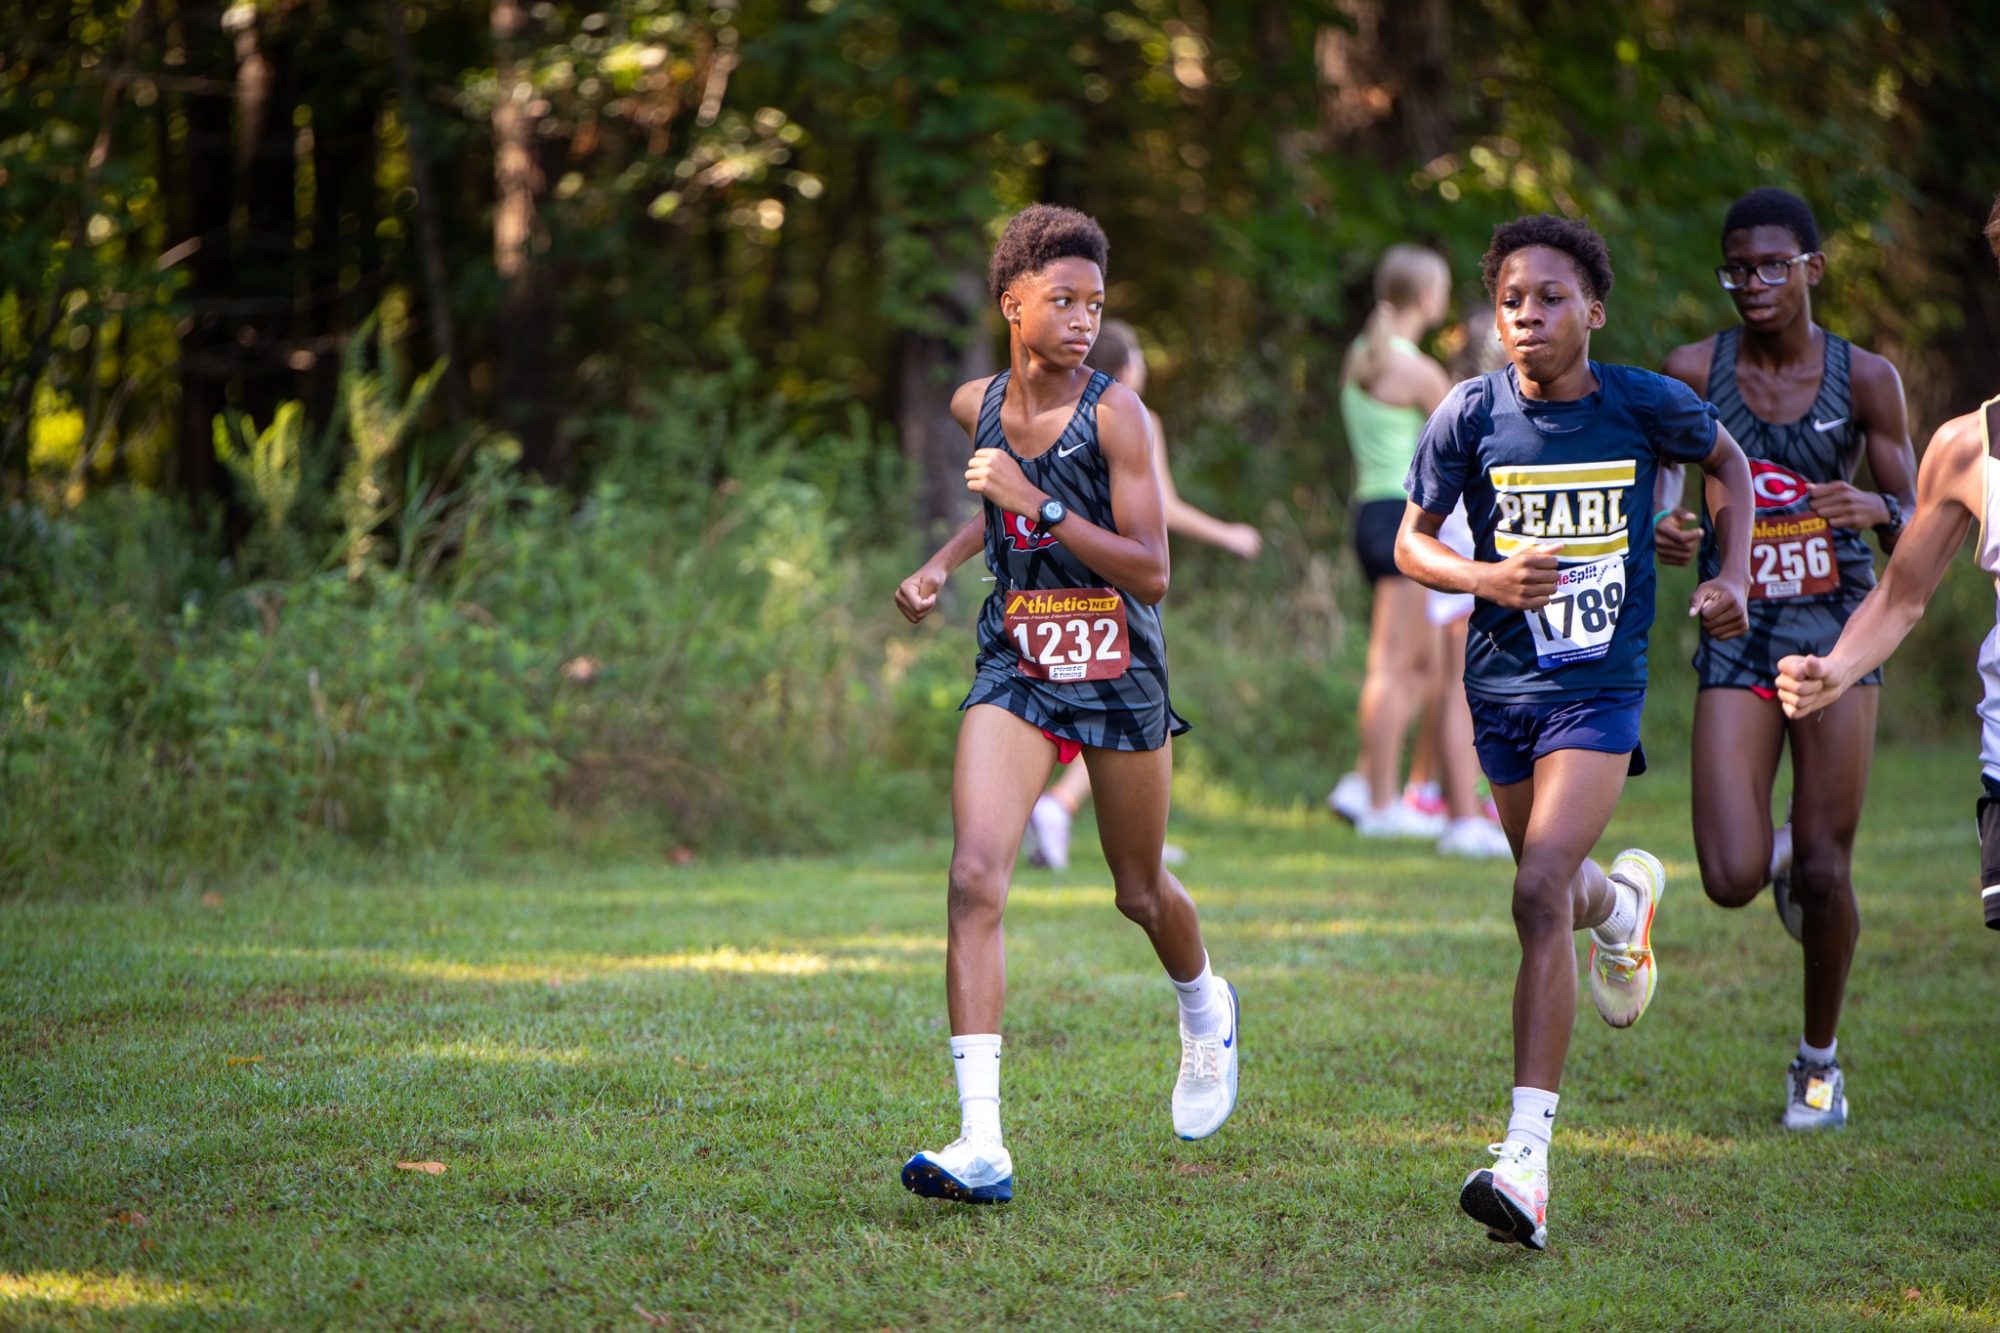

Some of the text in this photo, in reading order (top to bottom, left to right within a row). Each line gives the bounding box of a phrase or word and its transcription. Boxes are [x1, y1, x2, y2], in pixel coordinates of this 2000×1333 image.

[1753, 471, 1798, 501] C
[1495, 489, 1628, 536] PEARL
[1752, 521, 1800, 539] hletic
[1555, 565, 1598, 586] leSplit
[1750, 536, 1831, 584] 256
[1531, 582, 1623, 642] 1789
[1012, 618, 1122, 665] 1232
